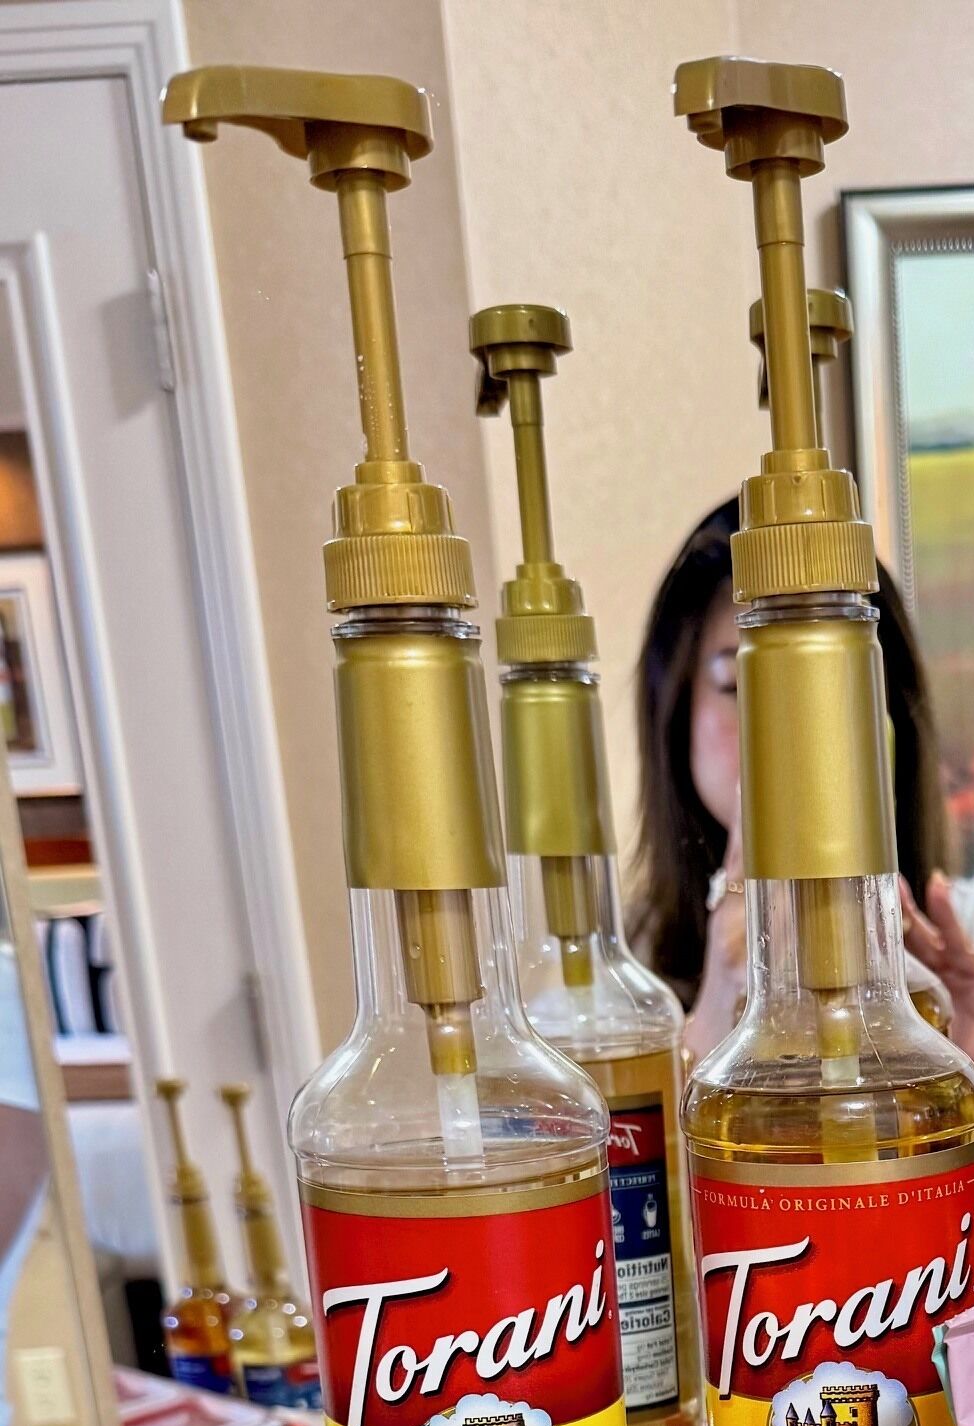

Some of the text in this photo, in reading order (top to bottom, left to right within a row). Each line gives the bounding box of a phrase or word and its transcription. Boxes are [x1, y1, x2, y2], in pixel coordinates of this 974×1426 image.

[704, 1179, 965, 1212] FORMULA ORIGINALE D'ITALIA
[701, 1211, 972, 1400] Torani
